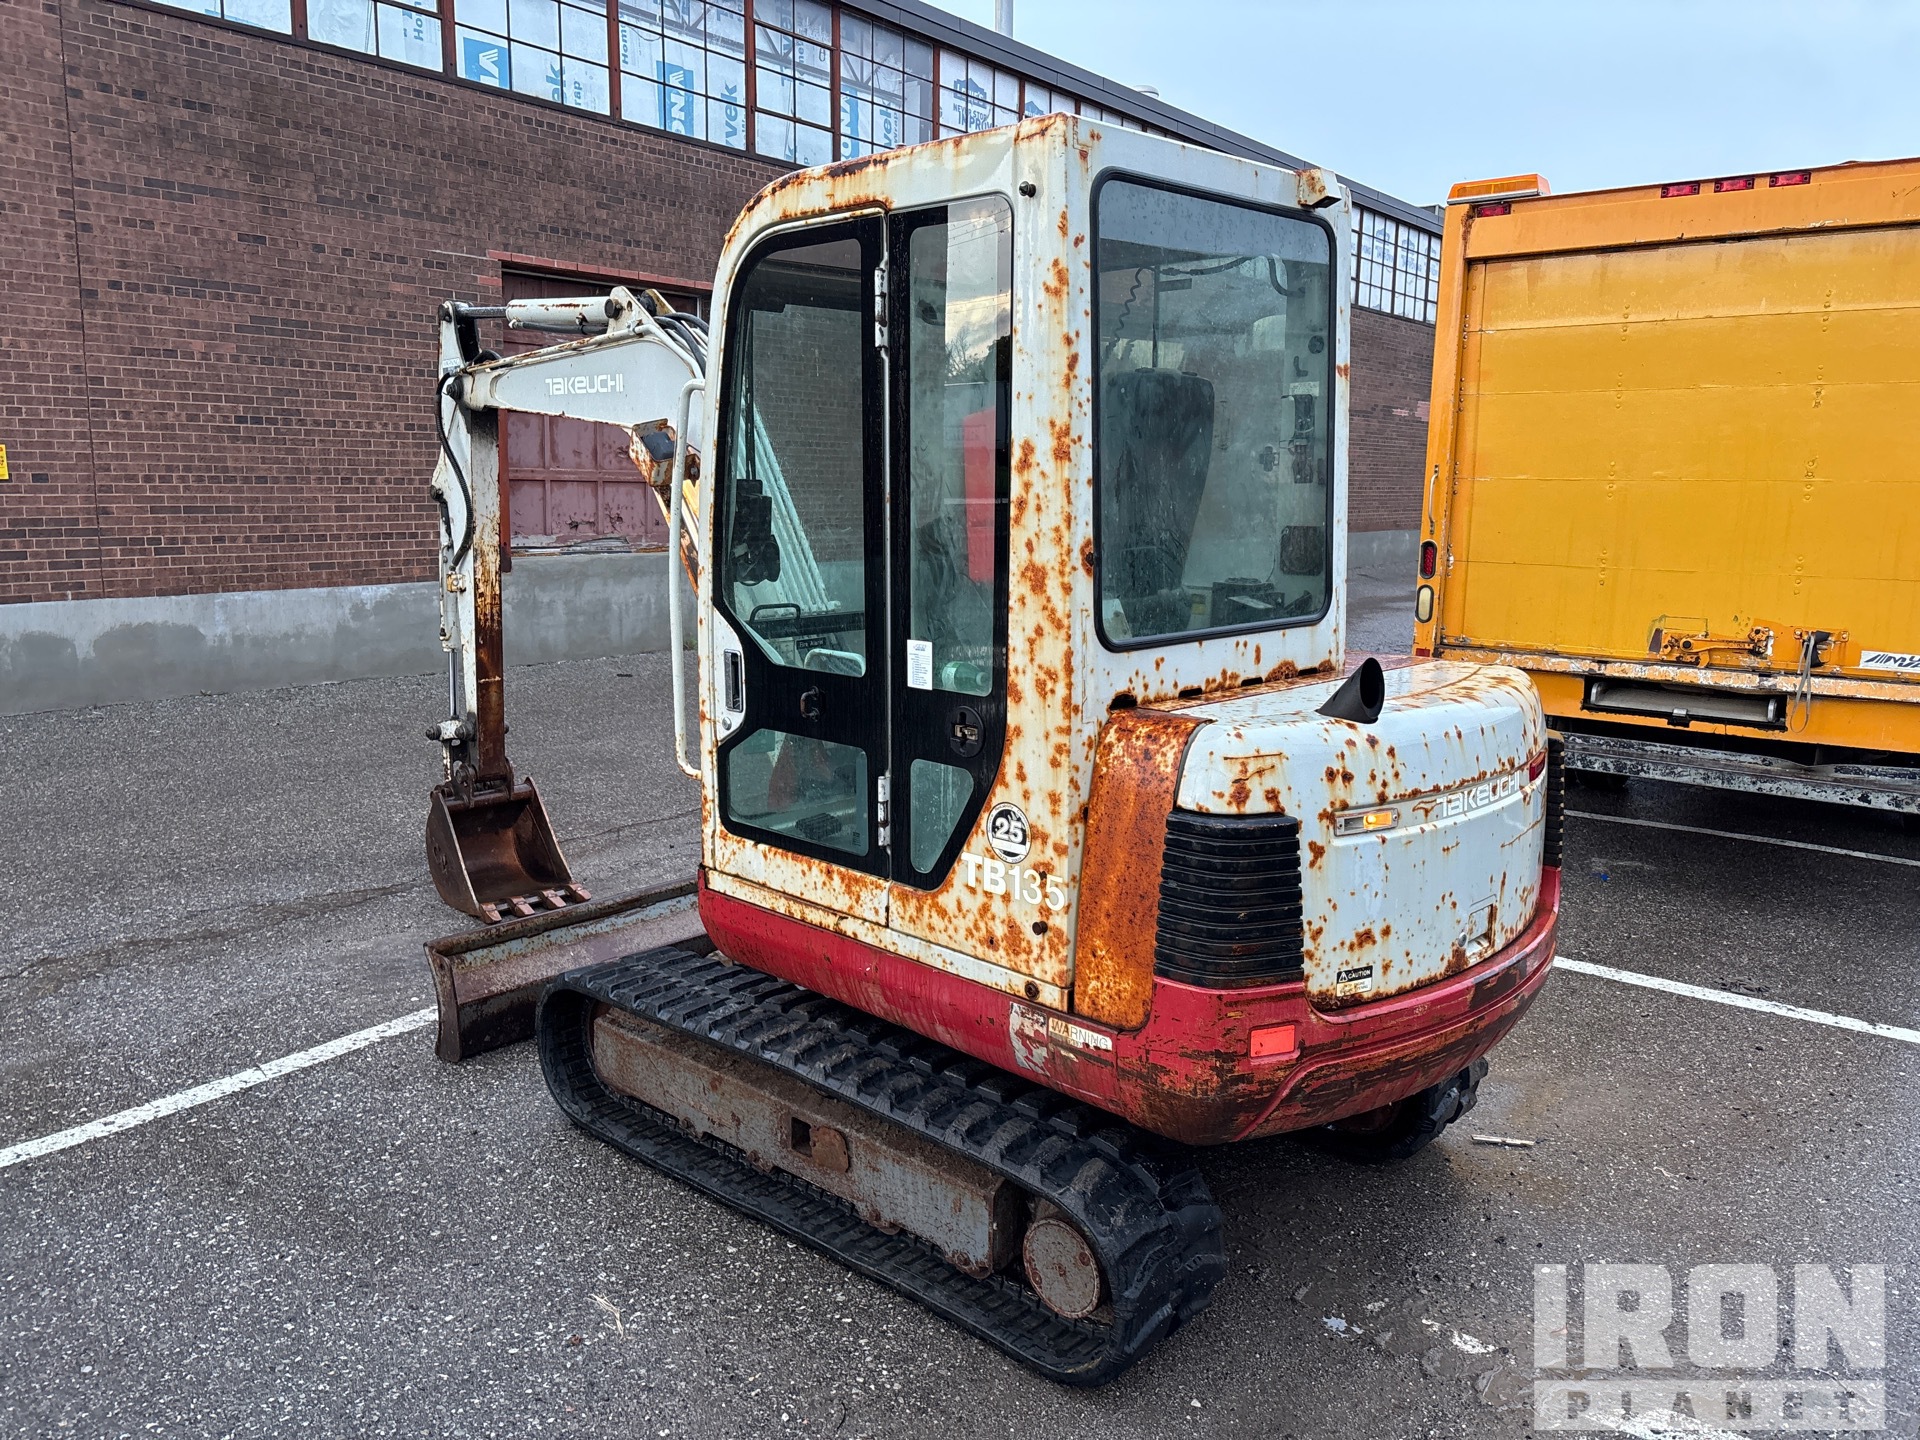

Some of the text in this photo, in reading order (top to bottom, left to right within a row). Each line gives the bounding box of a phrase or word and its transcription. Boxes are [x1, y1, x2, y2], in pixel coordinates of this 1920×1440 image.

[994, 816, 1024, 845] 25
[960, 851, 1066, 912] TB135
[1347, 969, 1371, 980] CAUTION
[1051, 1019, 1110, 1050] WARNING
